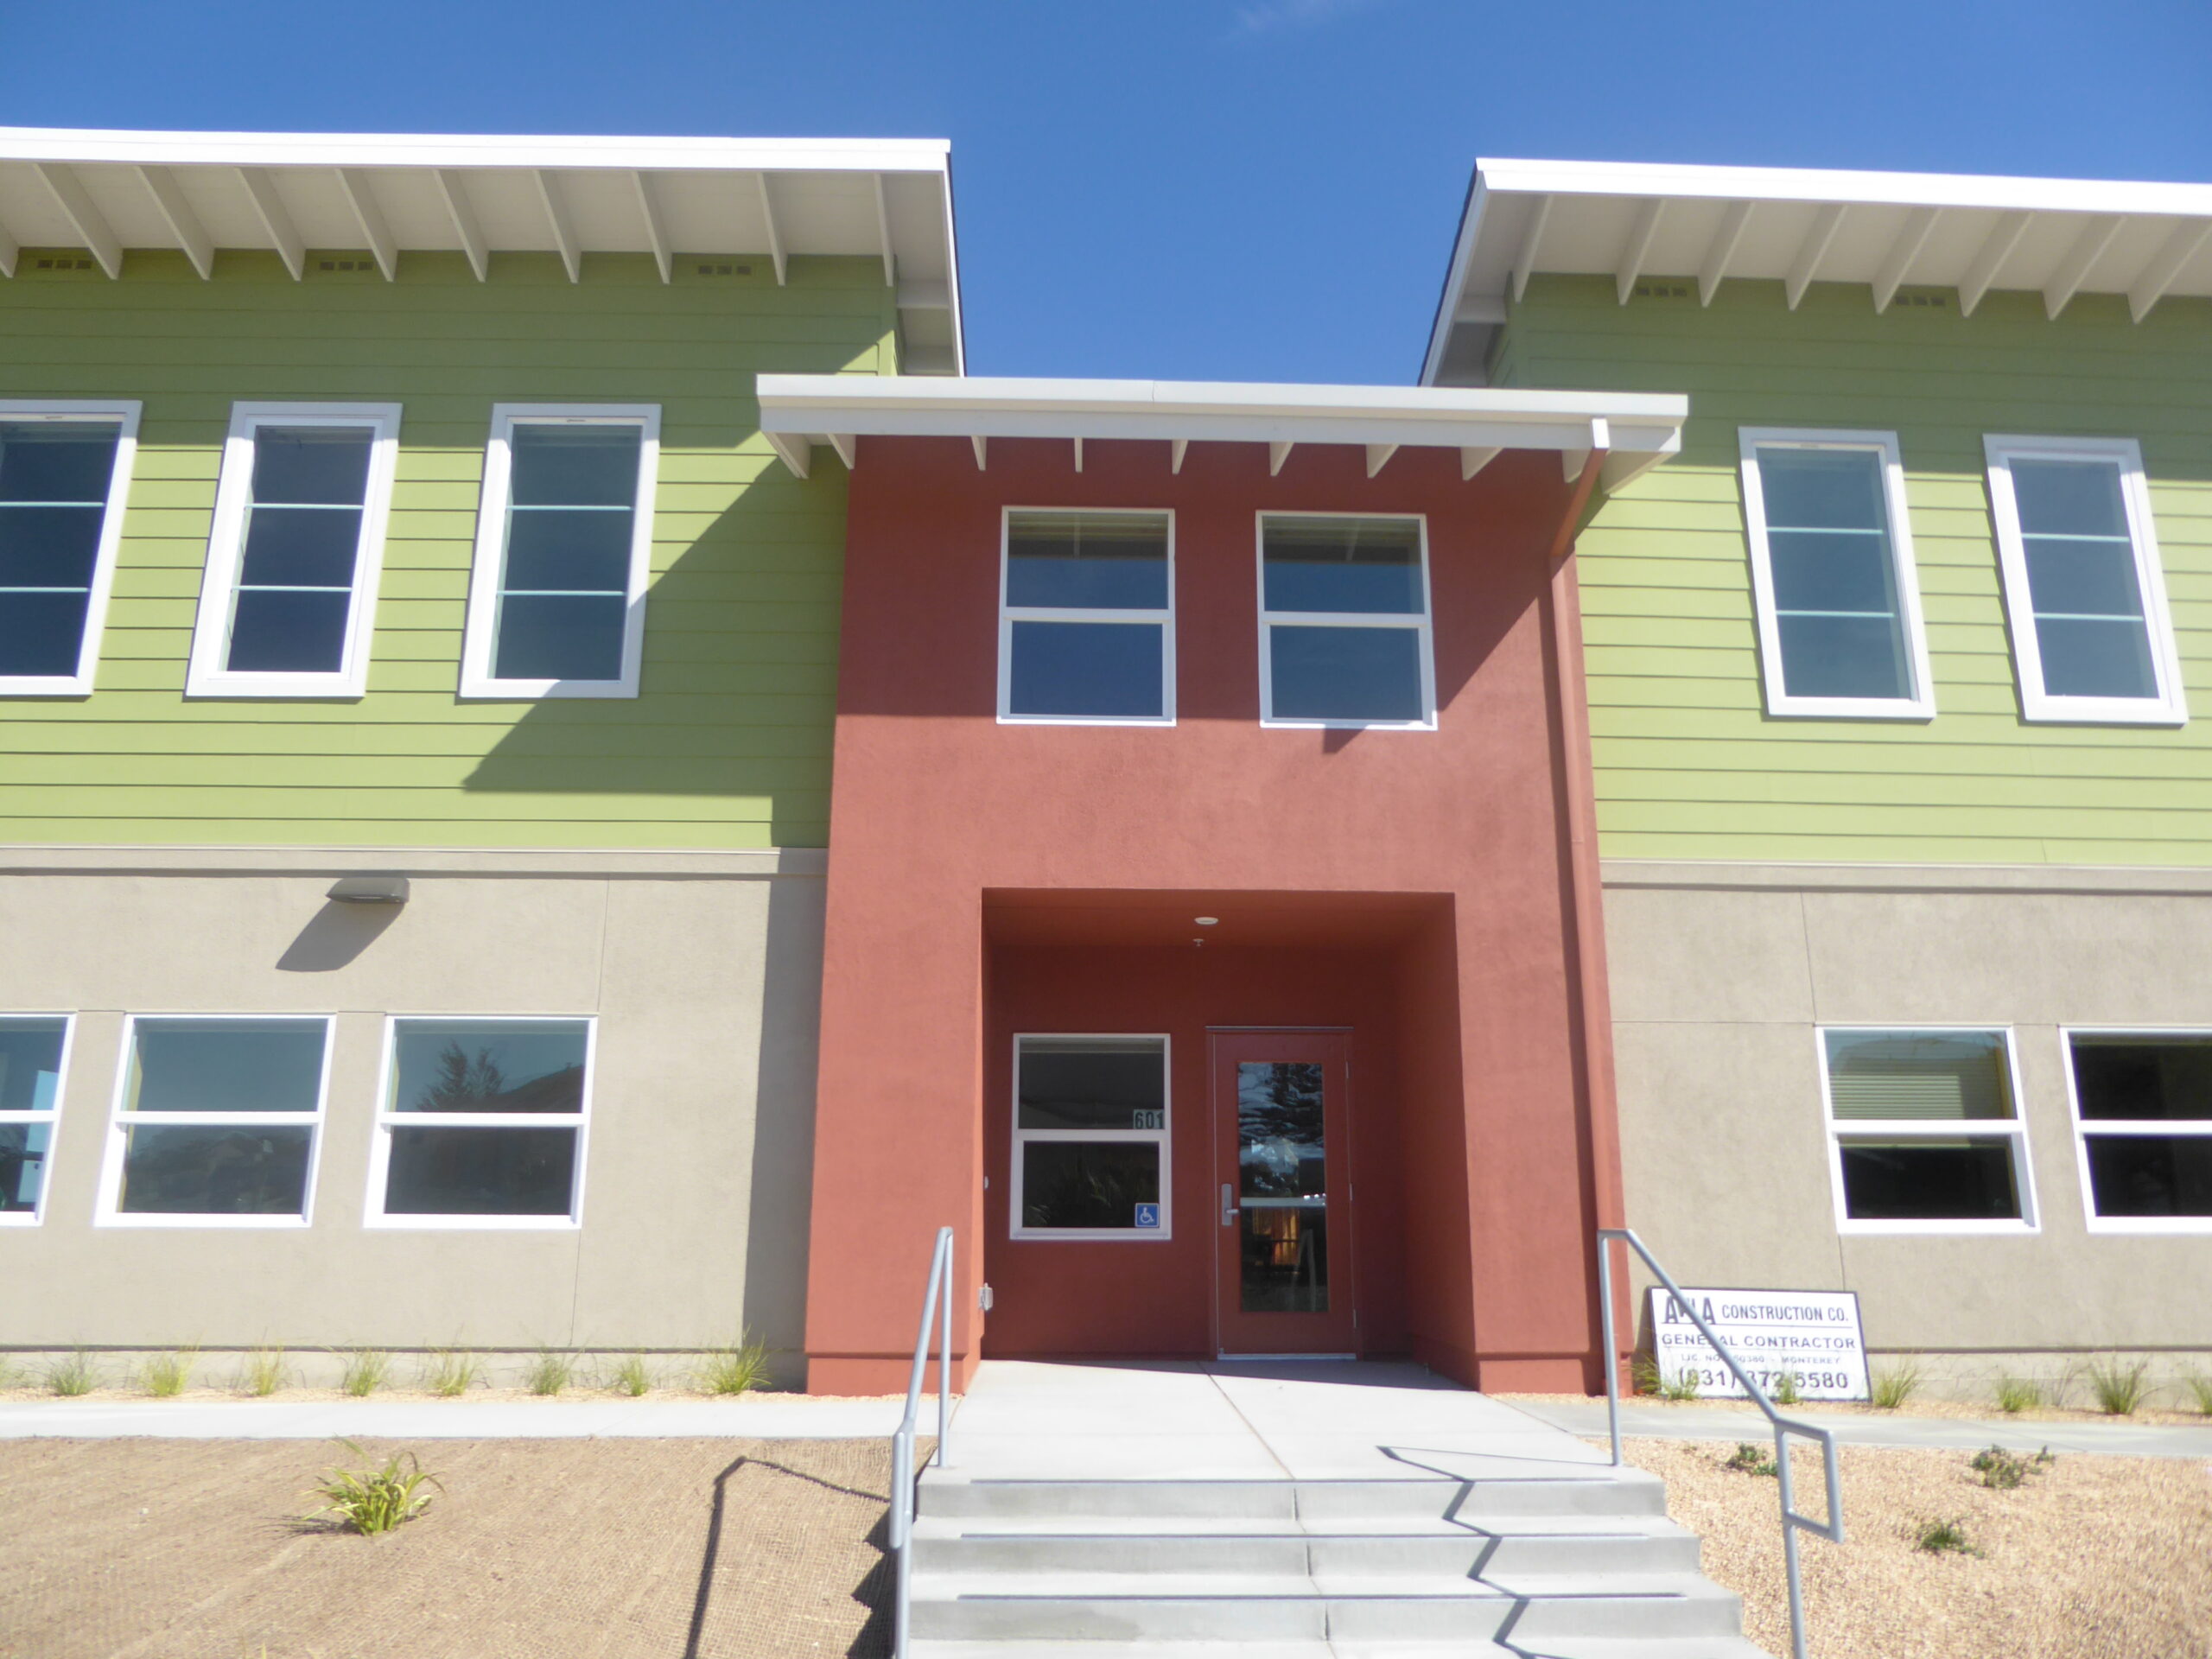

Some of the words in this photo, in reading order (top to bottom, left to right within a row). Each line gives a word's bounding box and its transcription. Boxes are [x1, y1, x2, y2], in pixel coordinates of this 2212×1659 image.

[1135, 1110, 1163, 1129] 601
[1722, 1304, 1823, 1322] CONSTRUCTION
[1827, 1306, 1849, 1322] CO.
[1662, 1332, 1738, 1347] GENEAL
[1743, 1335, 1856, 1349] CONTRACTOR
[1781, 1356, 1840, 1364] MONTEREY
